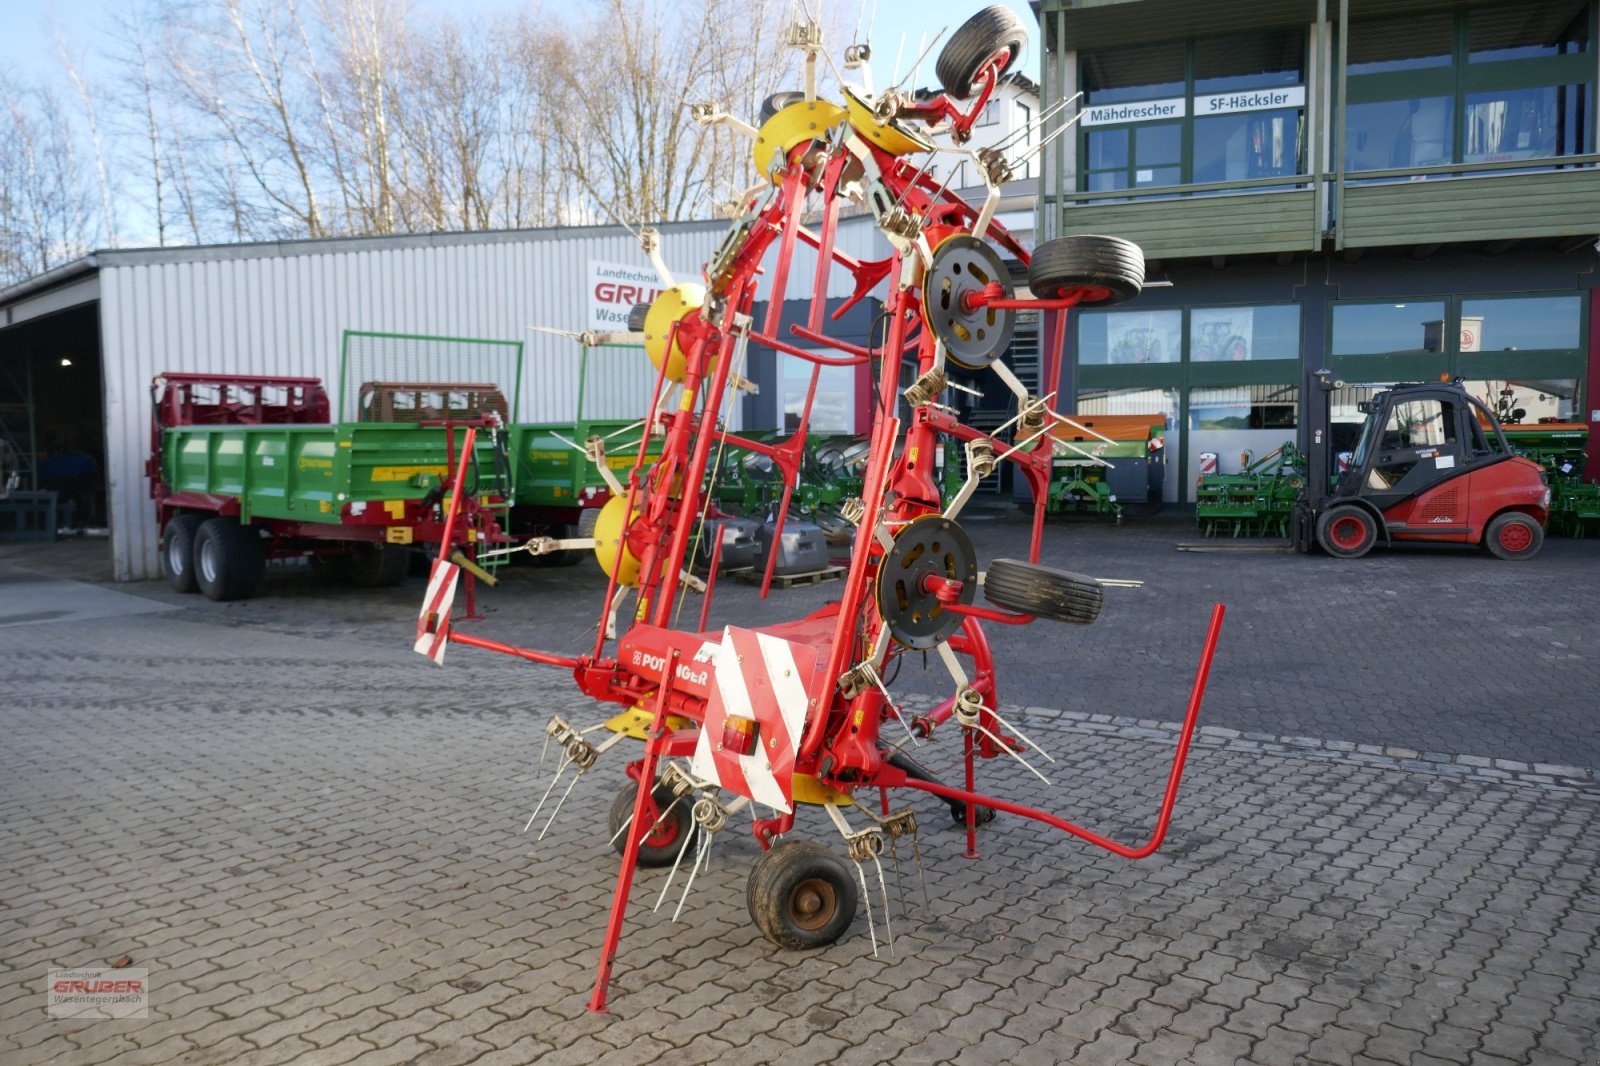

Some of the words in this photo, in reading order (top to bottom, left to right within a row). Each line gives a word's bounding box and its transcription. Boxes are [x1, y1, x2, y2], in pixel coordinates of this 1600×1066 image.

[1209, 92, 1289, 111] SF-Häcksler
[1090, 103, 1176, 122] Mähdrescher
[596, 266, 659, 283] Landtechnik
[594, 282, 667, 305] GRU
